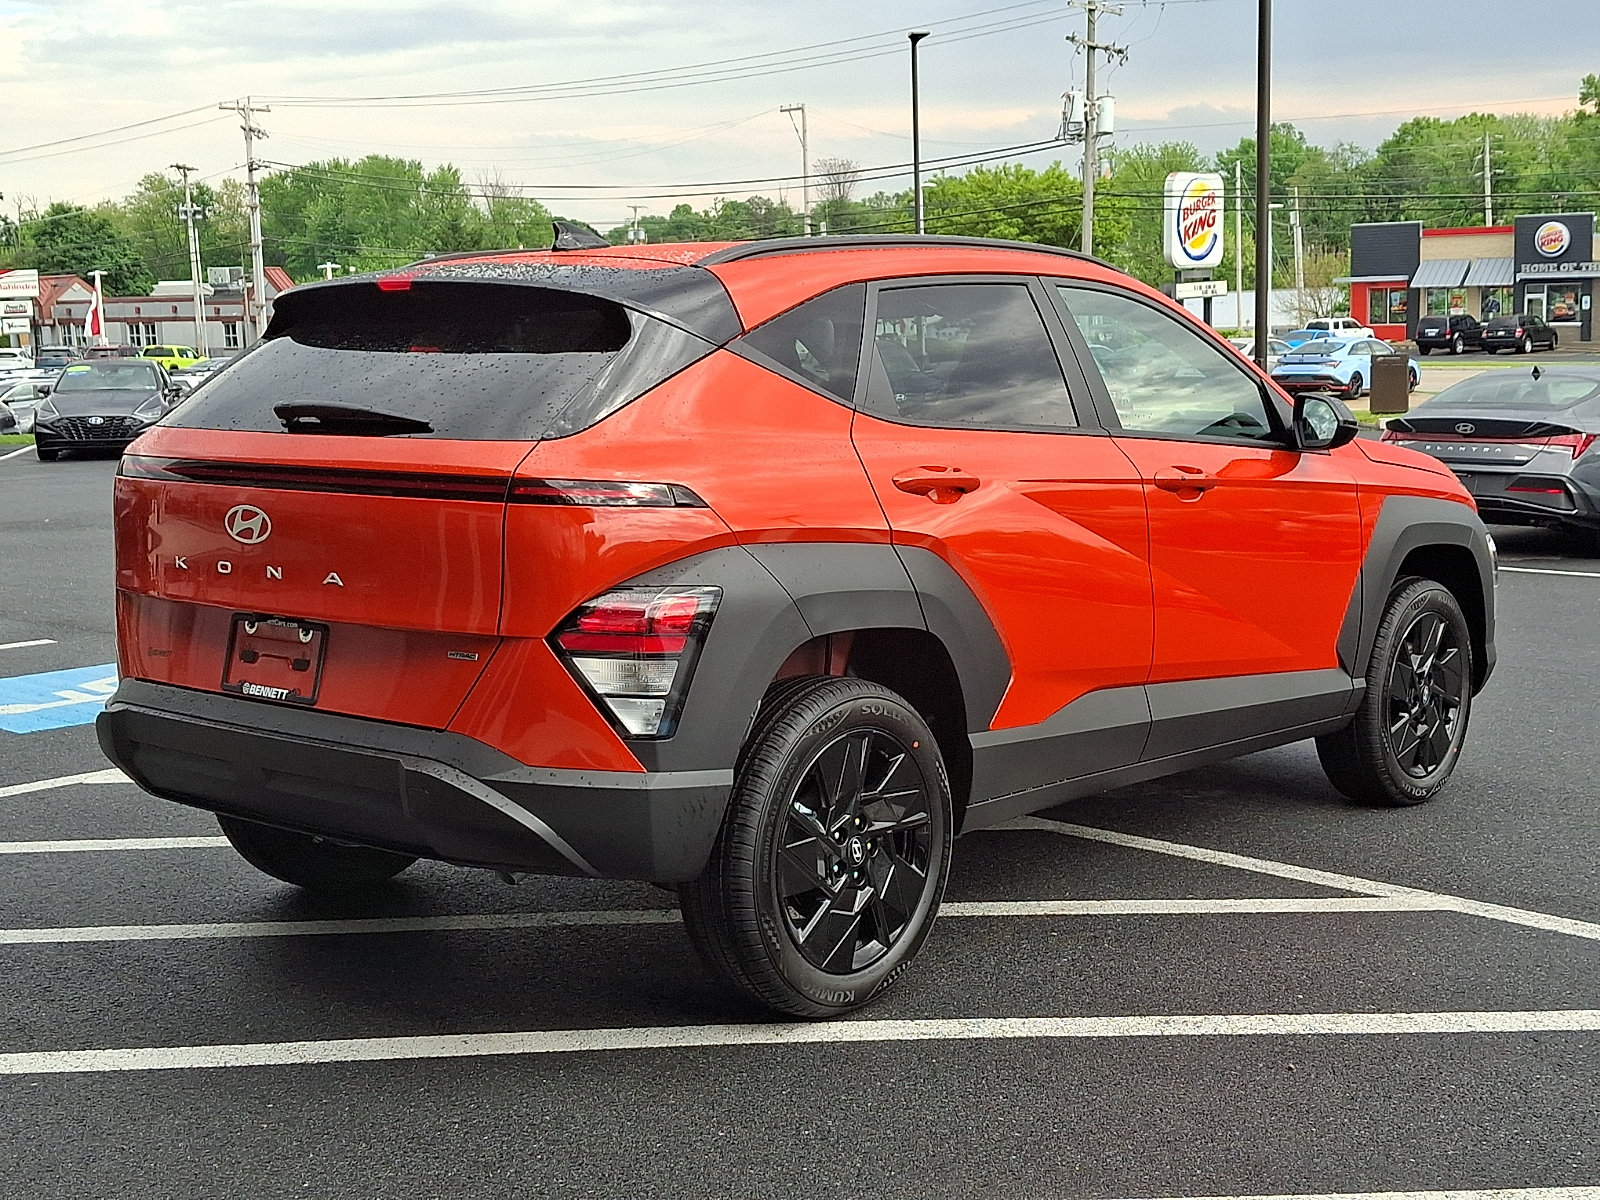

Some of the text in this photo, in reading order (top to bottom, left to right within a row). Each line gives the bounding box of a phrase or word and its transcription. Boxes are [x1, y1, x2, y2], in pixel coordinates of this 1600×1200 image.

[1183, 192, 1215, 222] BURGER
[1183, 209, 1216, 245] KING
[1541, 235, 1563, 247] KING
[1521, 263, 1558, 273] HOME
[1560, 262, 1577, 272] OF
[174, 555, 344, 587] KONA
[249, 684, 289, 700] BENNETT
